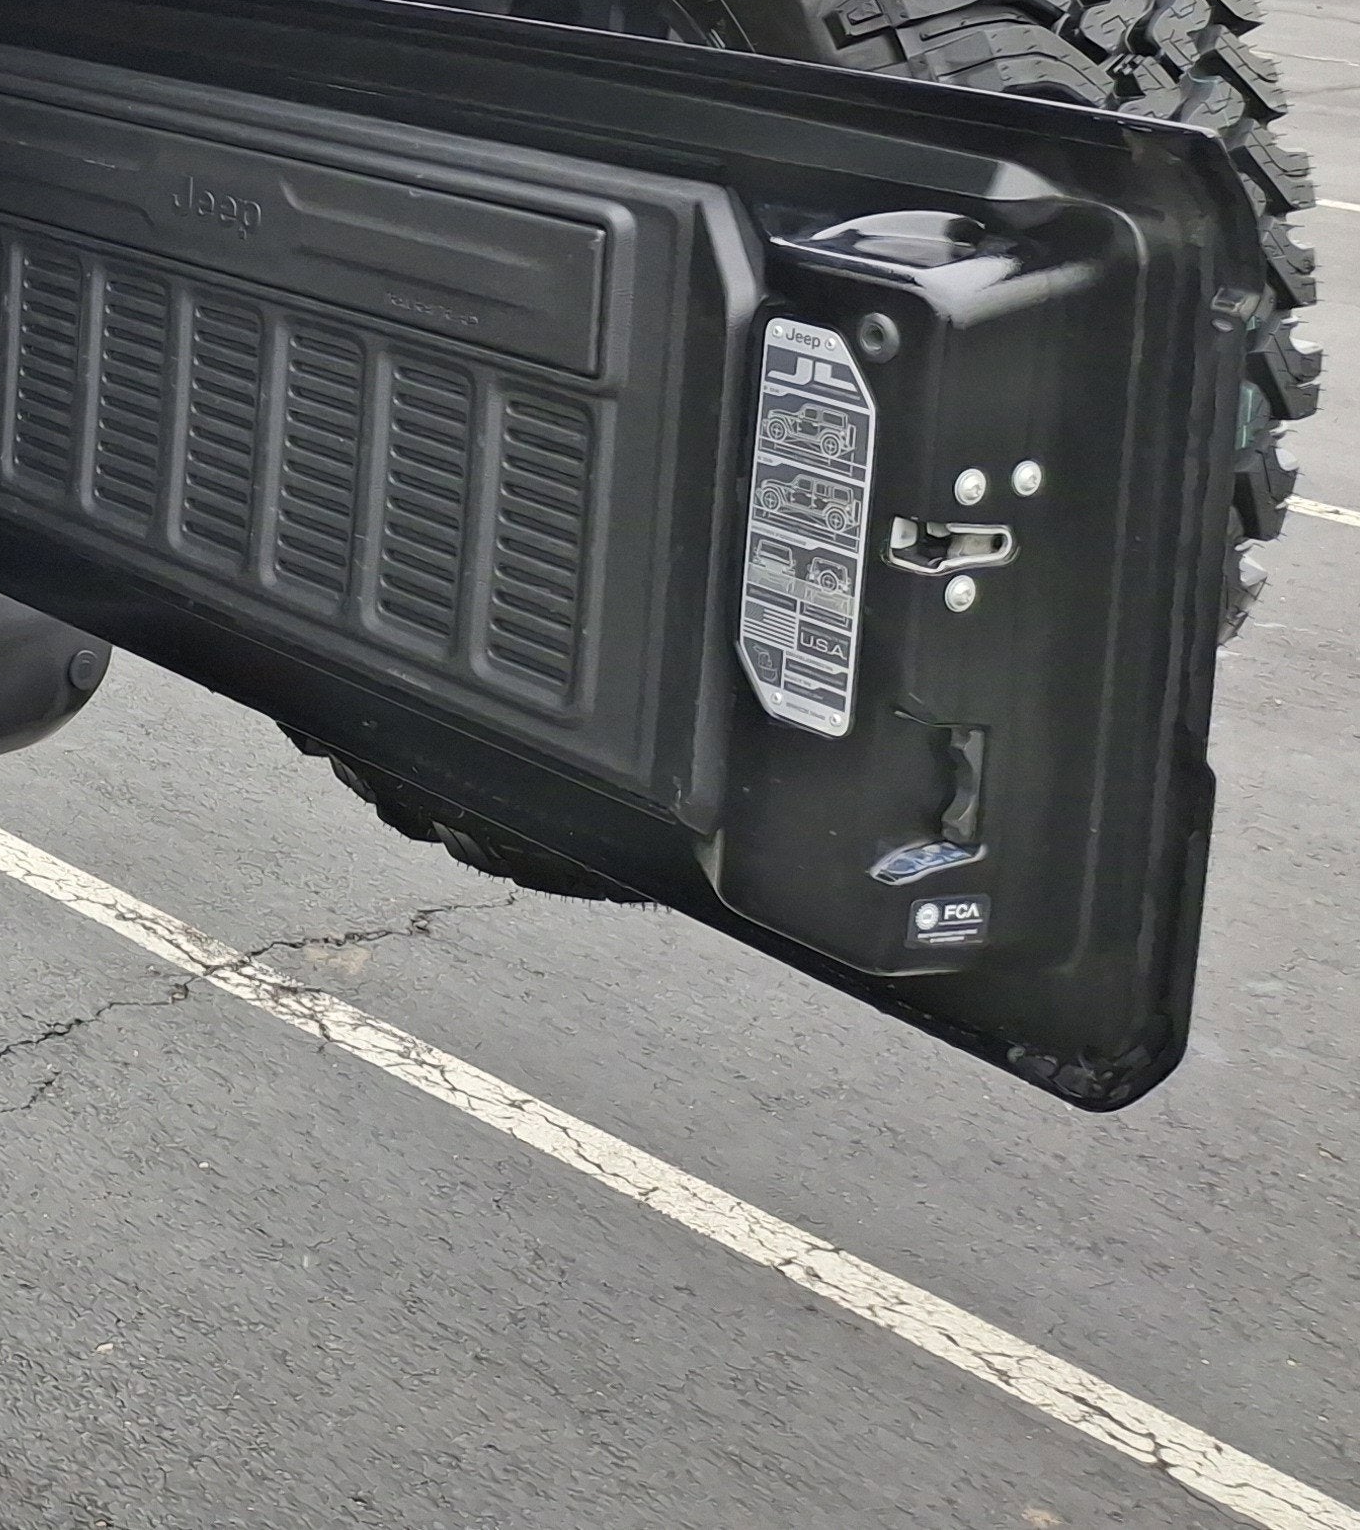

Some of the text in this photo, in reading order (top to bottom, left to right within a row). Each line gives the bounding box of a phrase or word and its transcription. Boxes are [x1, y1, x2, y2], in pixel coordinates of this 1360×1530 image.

[172, 175, 262, 240] Jeep
[785, 327, 821, 350] Jeep
[767, 357, 858, 392] JL
[943, 902, 980, 920] FCA
